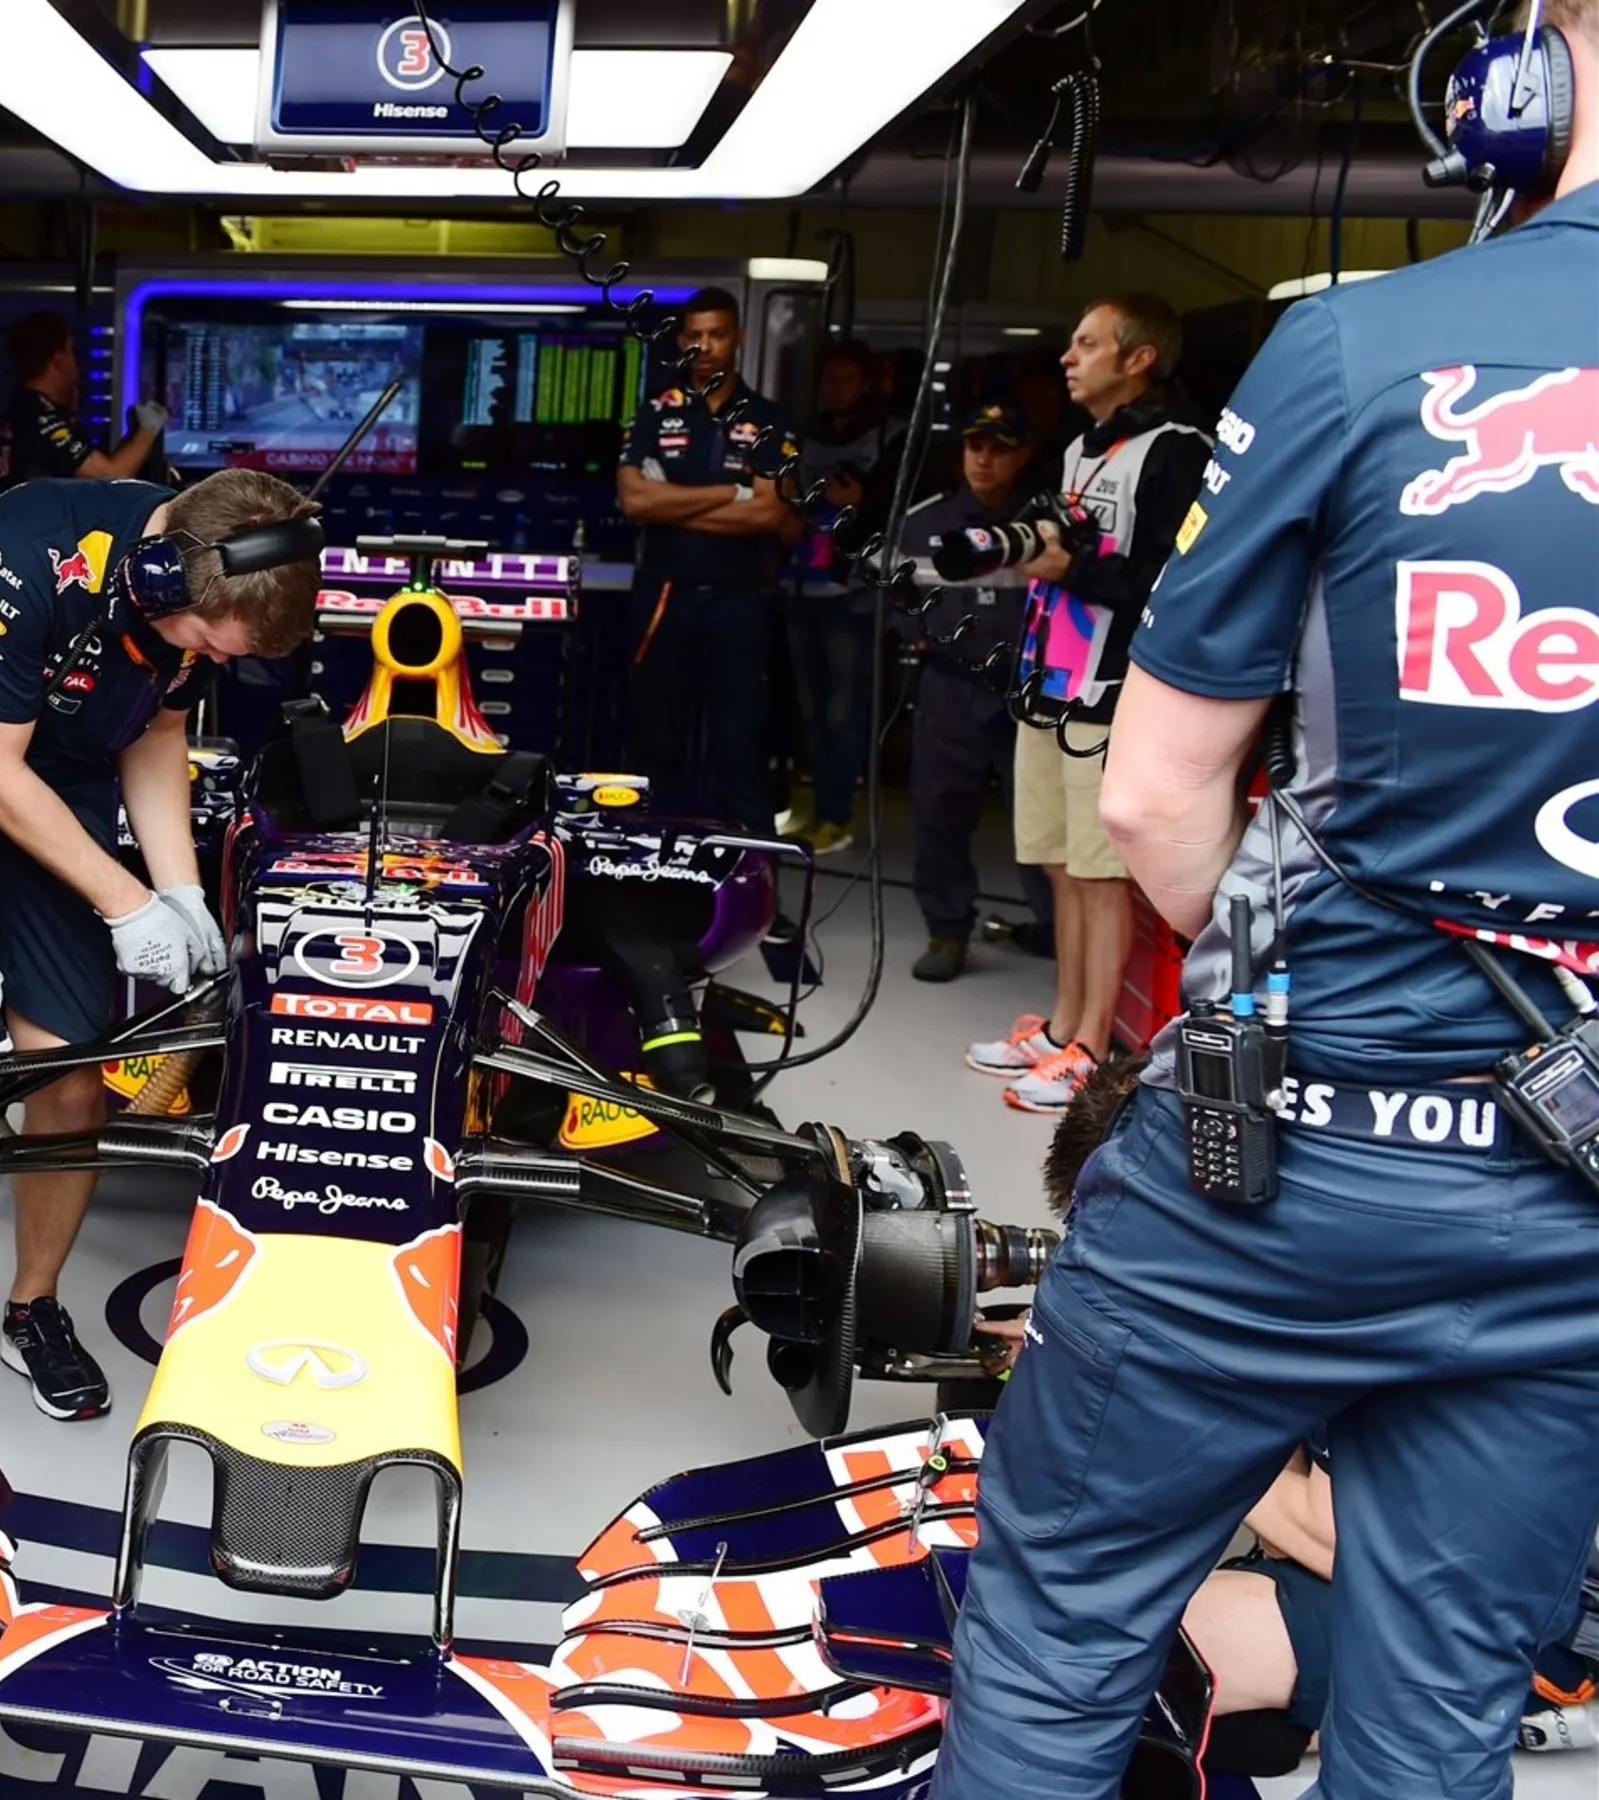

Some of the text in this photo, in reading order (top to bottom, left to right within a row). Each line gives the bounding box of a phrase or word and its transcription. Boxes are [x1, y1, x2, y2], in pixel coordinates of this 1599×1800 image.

[397, 30, 431, 76] 3
[373, 102, 449, 120] Hisense
[319, 547, 568, 582] INFNITI
[589, 855, 713, 884] Pepe Jeans
[329, 935, 387, 976] 3
[275, 992, 428, 1024] TOTAL
[271, 1028, 427, 1054] RENAULT
[268, 1061, 419, 1094] PIRELLI
[262, 1102, 417, 1134] CASIO
[1368, 1090, 1496, 1147] YOU
[256, 1141, 414, 1172] Hisense
[251, 1176, 410, 1214] Pepe Jeans
[193, 1663, 383, 1697] FOR ROAD SAFETY
[236, 1658, 342, 1681] ACTION
